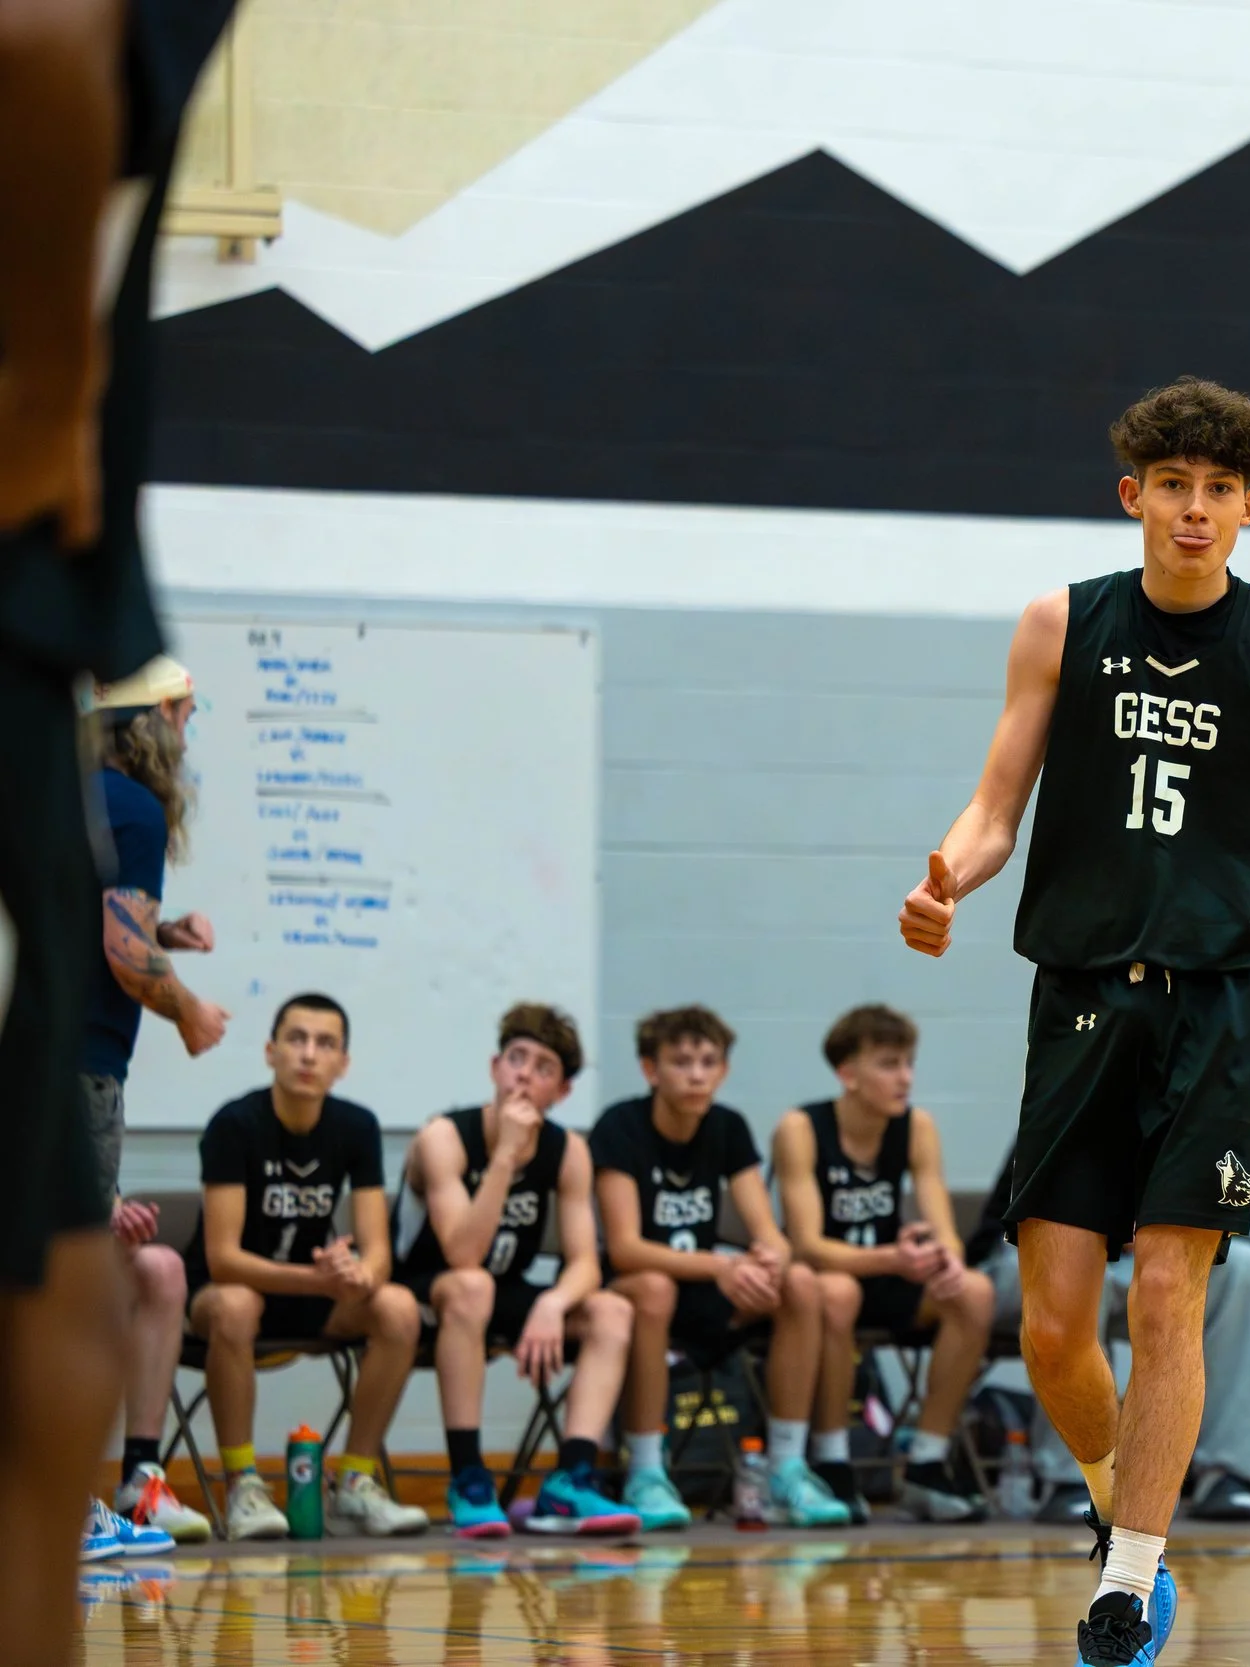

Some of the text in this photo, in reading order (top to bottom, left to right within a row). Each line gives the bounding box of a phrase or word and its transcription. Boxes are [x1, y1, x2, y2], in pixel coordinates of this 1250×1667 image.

[1114, 692, 1221, 750] GESS
[1126, 754, 1191, 836] 15
[262, 1183, 334, 1218] GESS
[653, 1186, 713, 1228] GESS
[831, 1181, 895, 1222] GESS
[273, 1223, 297, 1260] 1
